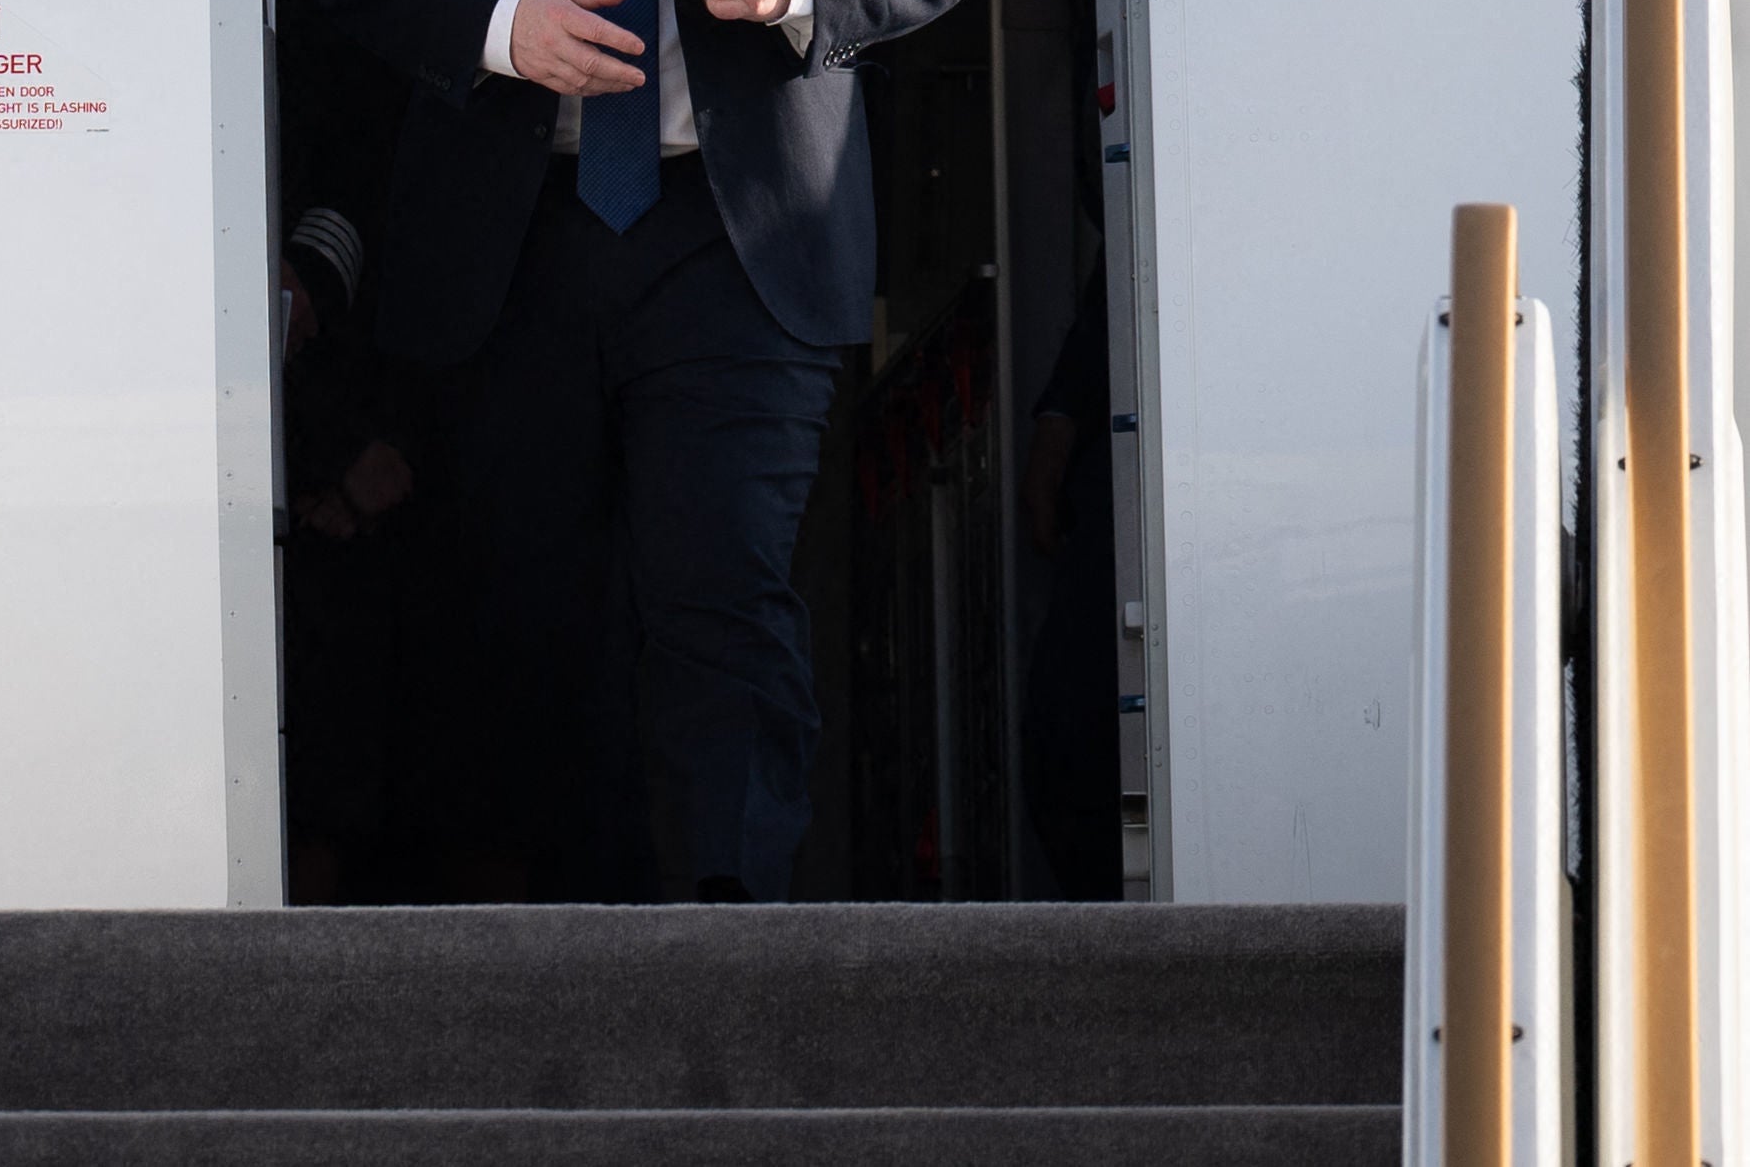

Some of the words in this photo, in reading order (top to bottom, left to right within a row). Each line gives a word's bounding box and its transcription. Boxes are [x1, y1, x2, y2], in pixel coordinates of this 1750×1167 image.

[19, 85, 55, 97] DOOR
[26, 102, 40, 114] IS
[43, 101, 108, 114] FLASHING
